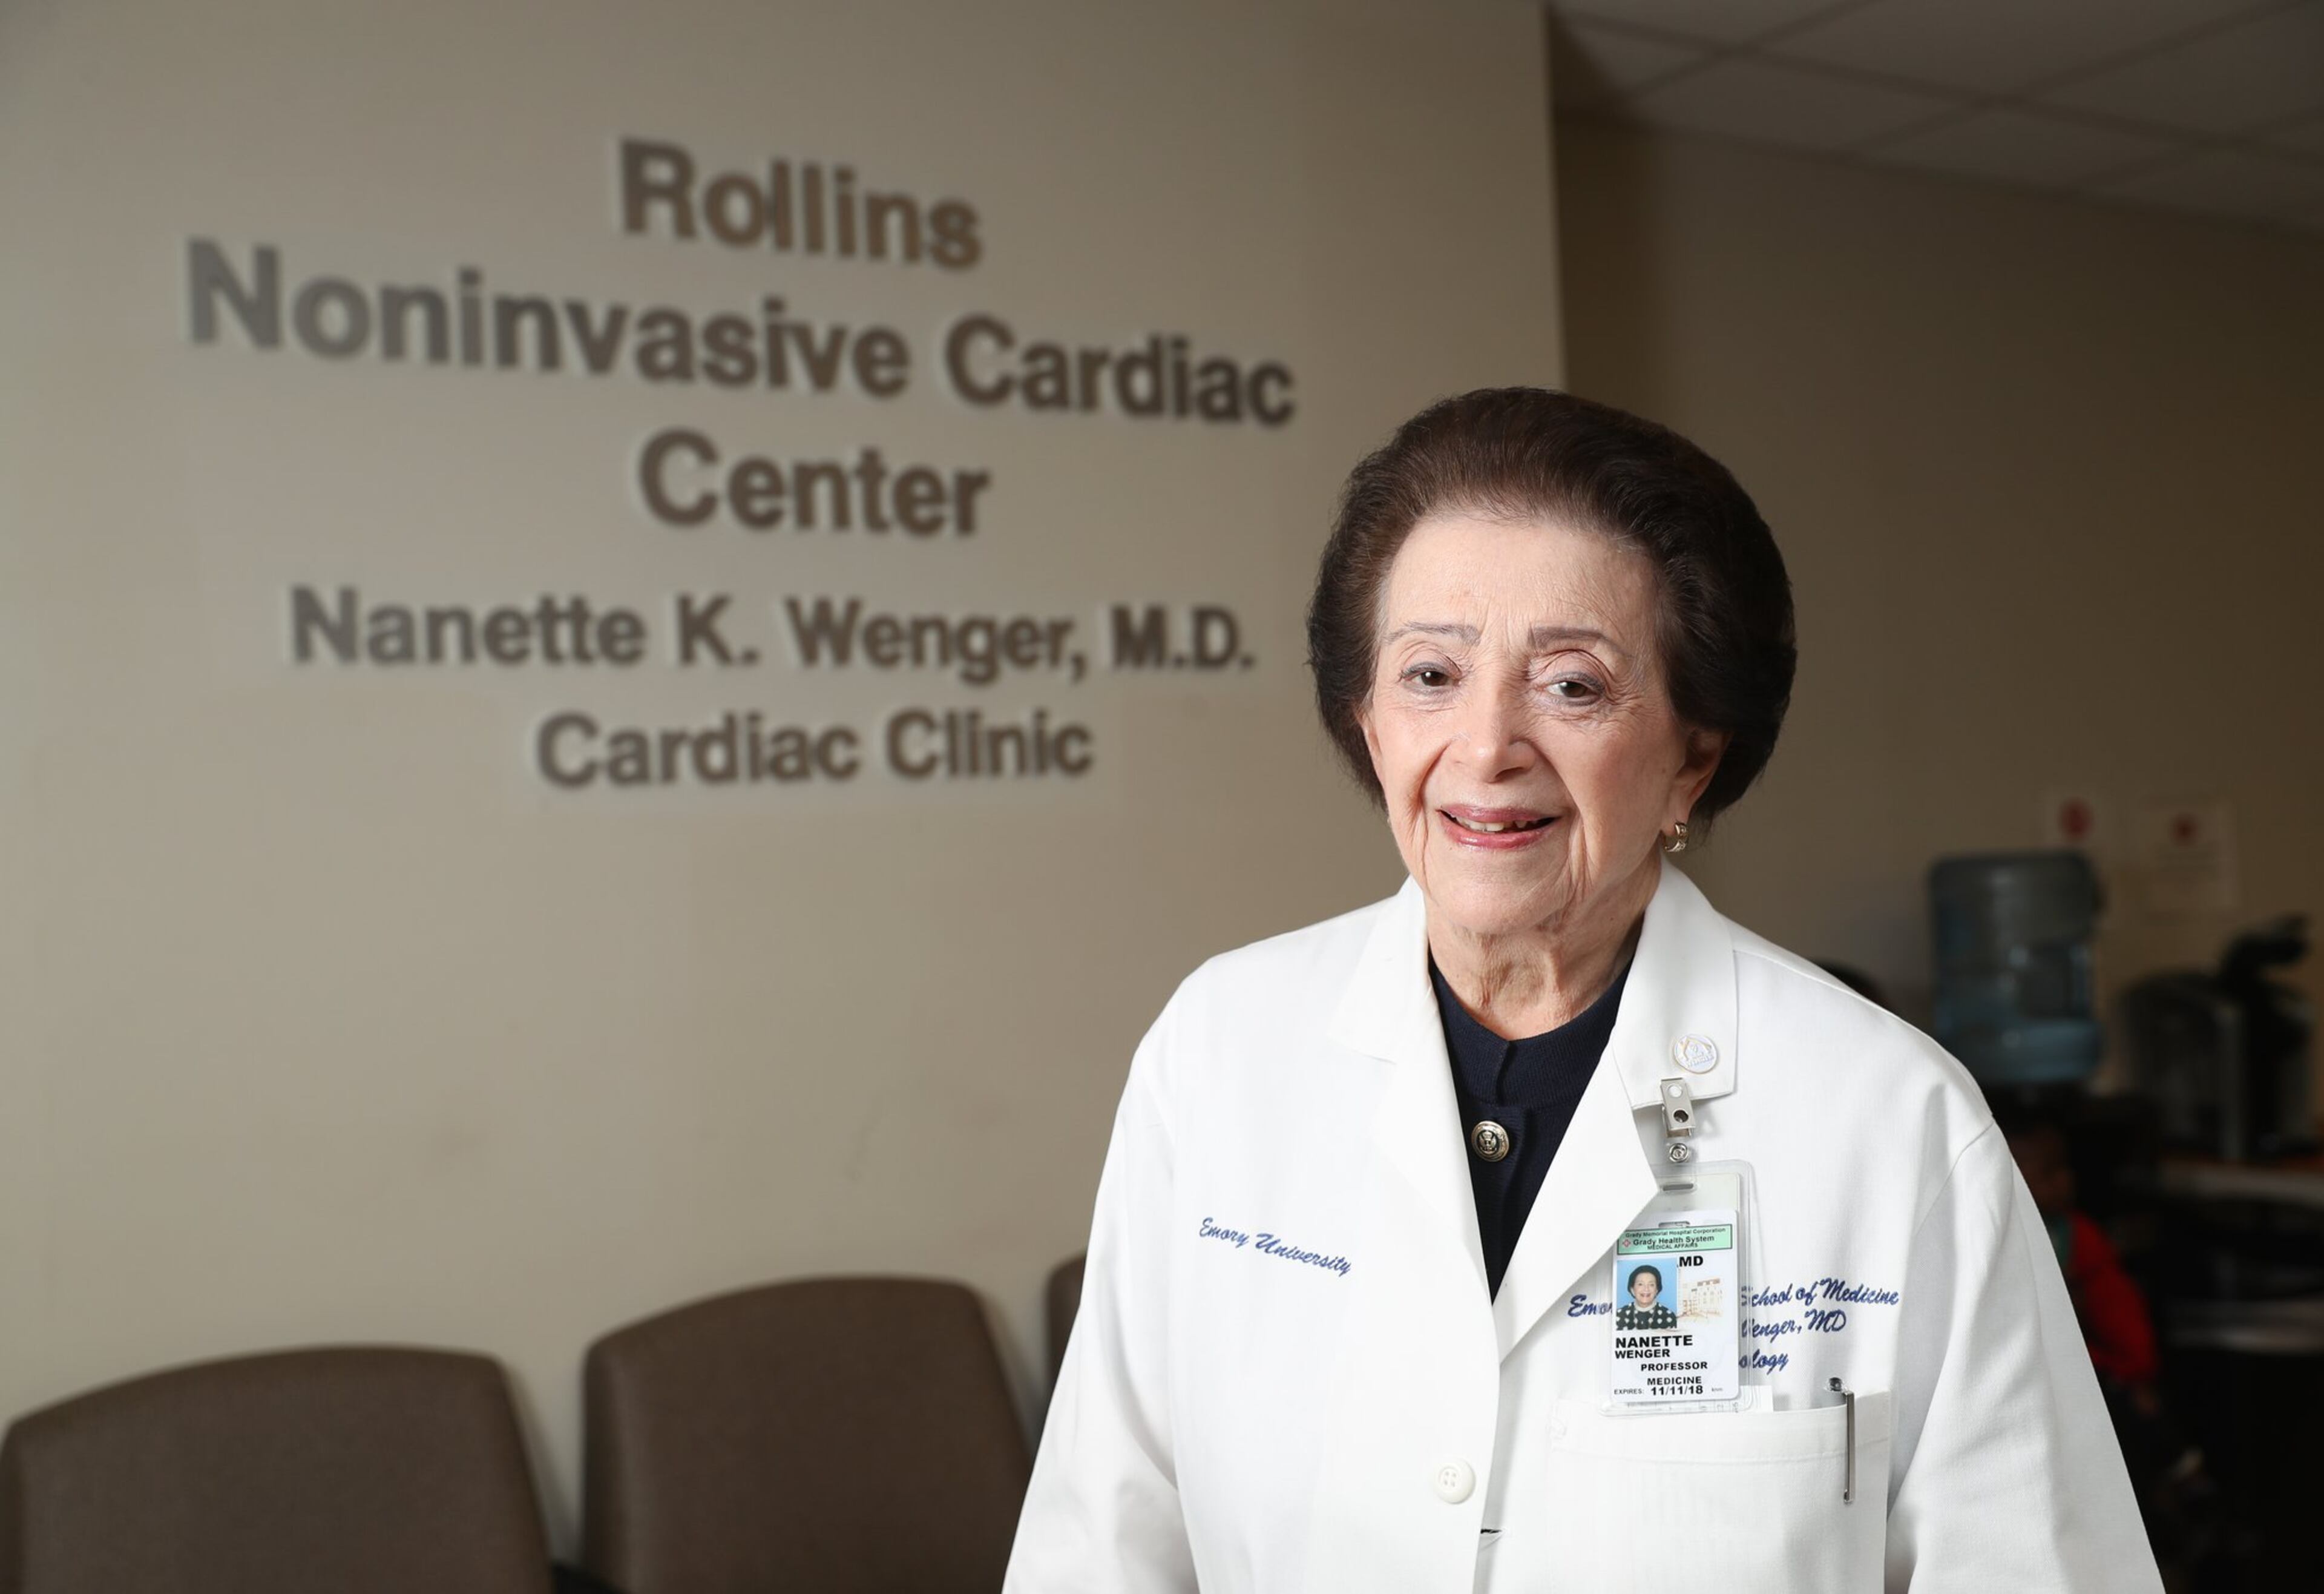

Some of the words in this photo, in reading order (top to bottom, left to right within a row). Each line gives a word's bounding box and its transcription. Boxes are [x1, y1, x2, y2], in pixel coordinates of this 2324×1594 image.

[620, 138, 983, 271] Rollins
[186, 237, 910, 398] Noninvasive
[944, 312, 1295, 427] Cardiac
[638, 427, 990, 538] Center
[290, 585, 646, 666] Nanette
[675, 594, 760, 666] K.
[785, 598, 1087, 687] Wenger,
[1111, 604, 1255, 671] M.D.
[536, 712, 861, 789] Cardiac
[887, 708, 1095, 780] Clinic
[1200, 1217, 1250, 1248] Emory
[1255, 1233, 1351, 1277] University
[1633, 1238, 1656, 1249] Grady
[1686, 1236, 1715, 1245] System
[1795, 1280, 1820, 1306] of
[1818, 1277, 1899, 1305] Medicine
[1804, 1308, 1846, 1332] MD
[1615, 1334, 1693, 1349] NANETTE
[1615, 1348, 1671, 1359] WENGER
[1641, 1362, 1709, 1372] PROFESSOR
[1647, 1375, 1702, 1386] MEDICINE
[1650, 1385, 1703, 1395] 11/11/18
